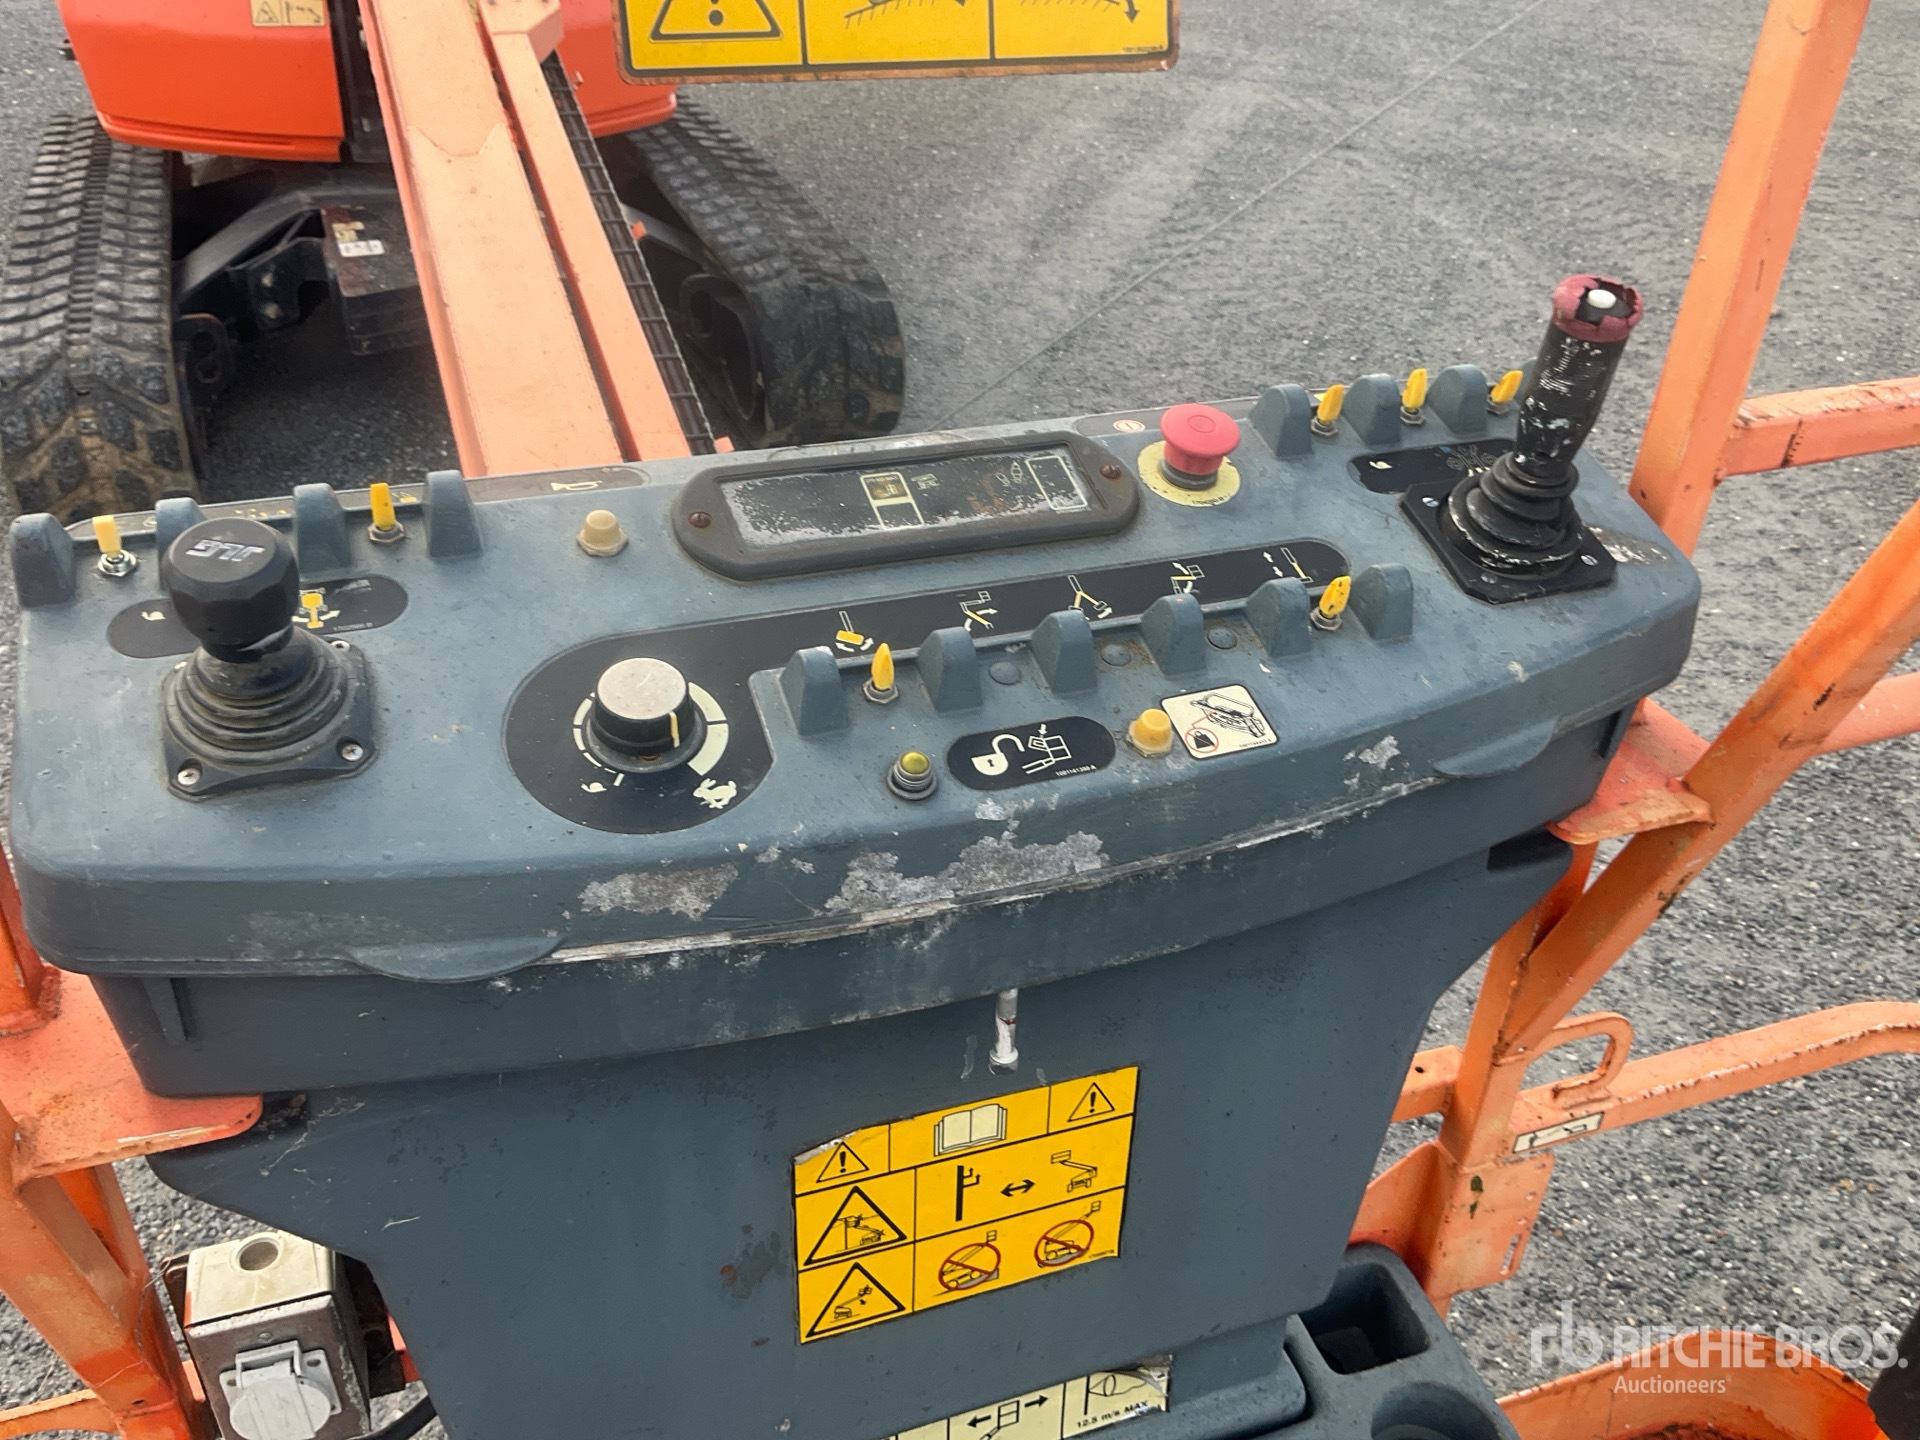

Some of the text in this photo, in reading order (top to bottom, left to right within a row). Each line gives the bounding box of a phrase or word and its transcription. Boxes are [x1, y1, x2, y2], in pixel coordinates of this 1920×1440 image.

[185, 538, 266, 562] JLG
[1077, 1400, 1149, 1429] 12.5 m/s MAX
